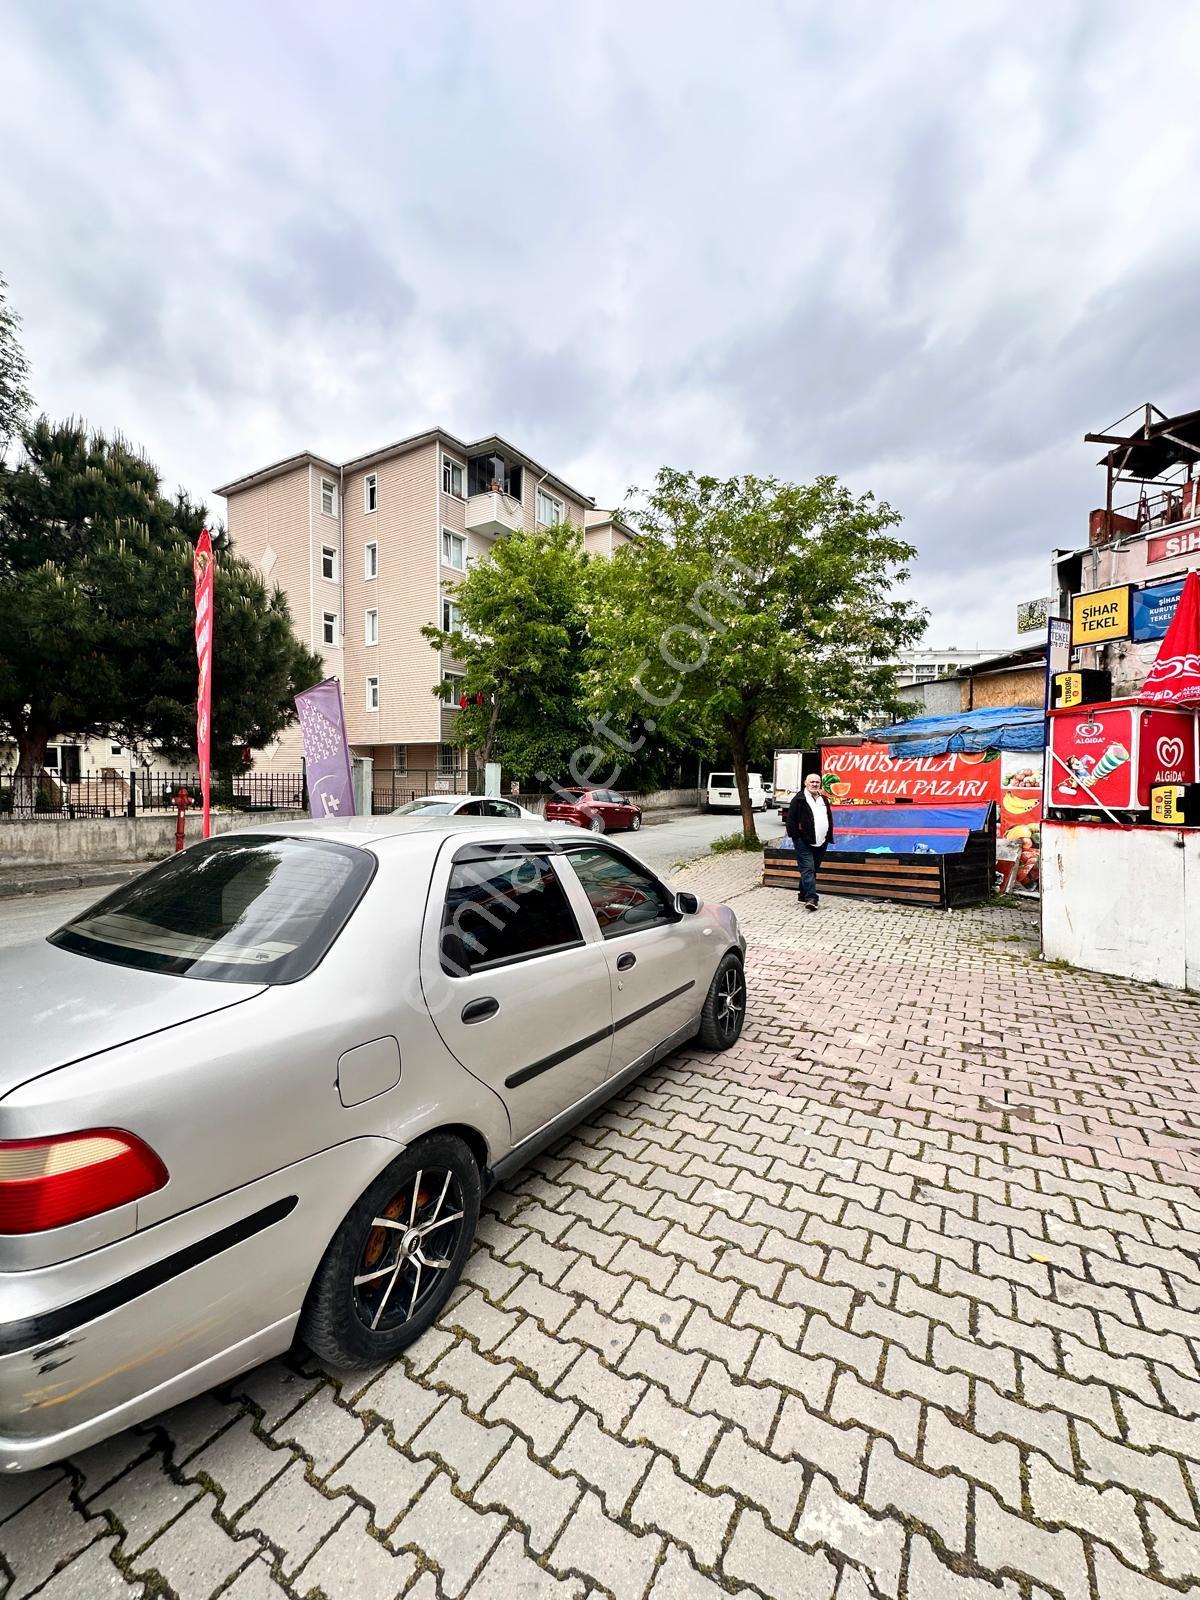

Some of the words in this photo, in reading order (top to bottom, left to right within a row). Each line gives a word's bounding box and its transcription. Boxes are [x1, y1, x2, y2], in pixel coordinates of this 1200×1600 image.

[1082, 602, 1118, 620] ŞİHAR
[1151, 613, 1172, 623] TEKEL
[1081, 616, 1119, 632] TEKEL
[1051, 631, 1069, 643] TEKEL
[1064, 676, 1072, 703] TUBORG
[863, 779, 912, 795] HALK
[912, 780, 988, 797] PAZARI
[1163, 789, 1172, 819] TUBORG
